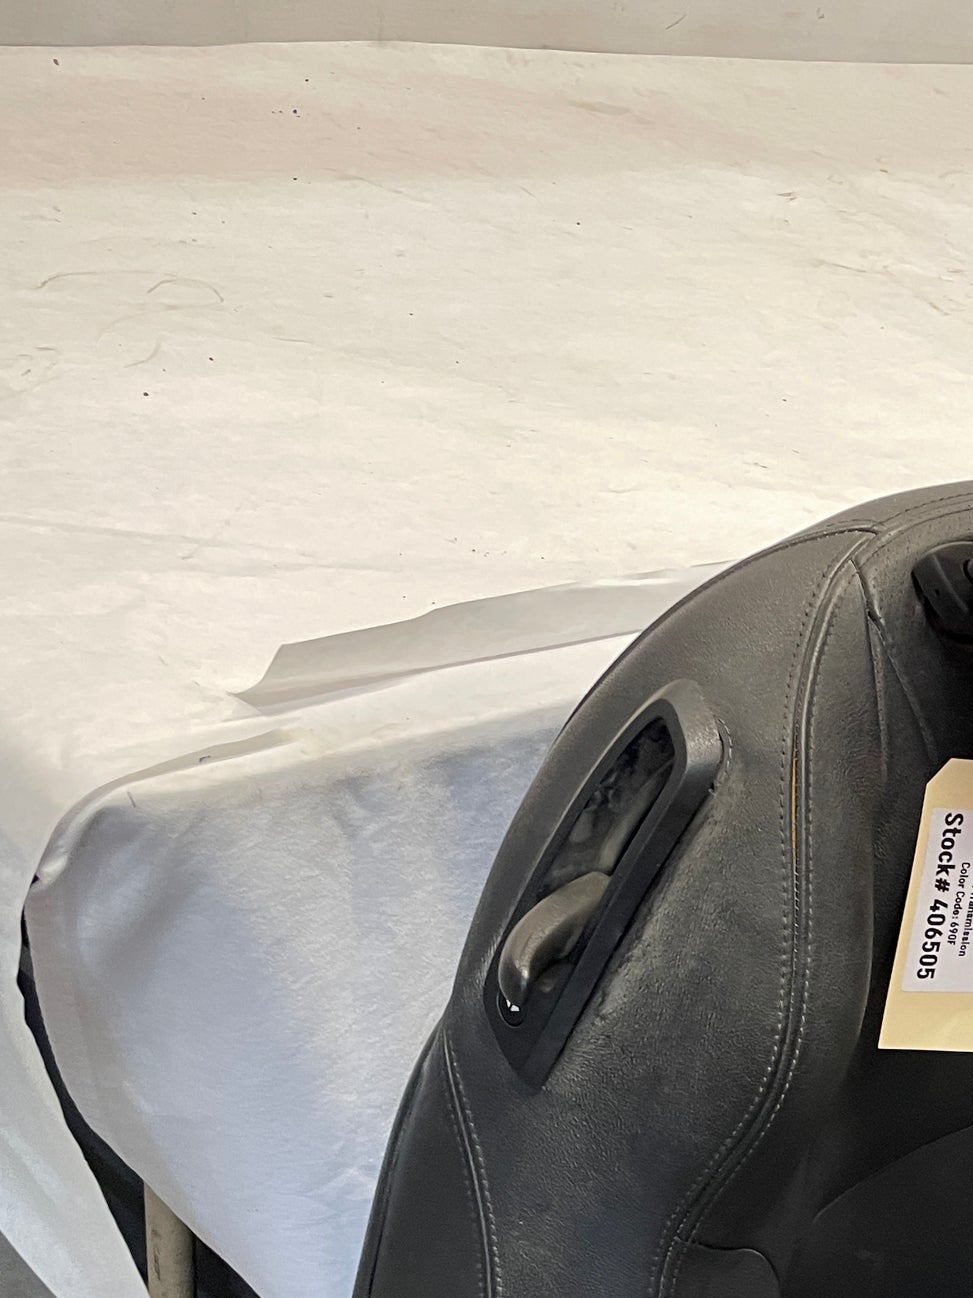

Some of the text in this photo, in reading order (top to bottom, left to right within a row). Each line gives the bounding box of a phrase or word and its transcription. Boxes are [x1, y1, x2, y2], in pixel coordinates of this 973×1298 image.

[916, 812, 964, 979] Stock# 406505
[947, 862, 970, 945] Color Code: 690F
